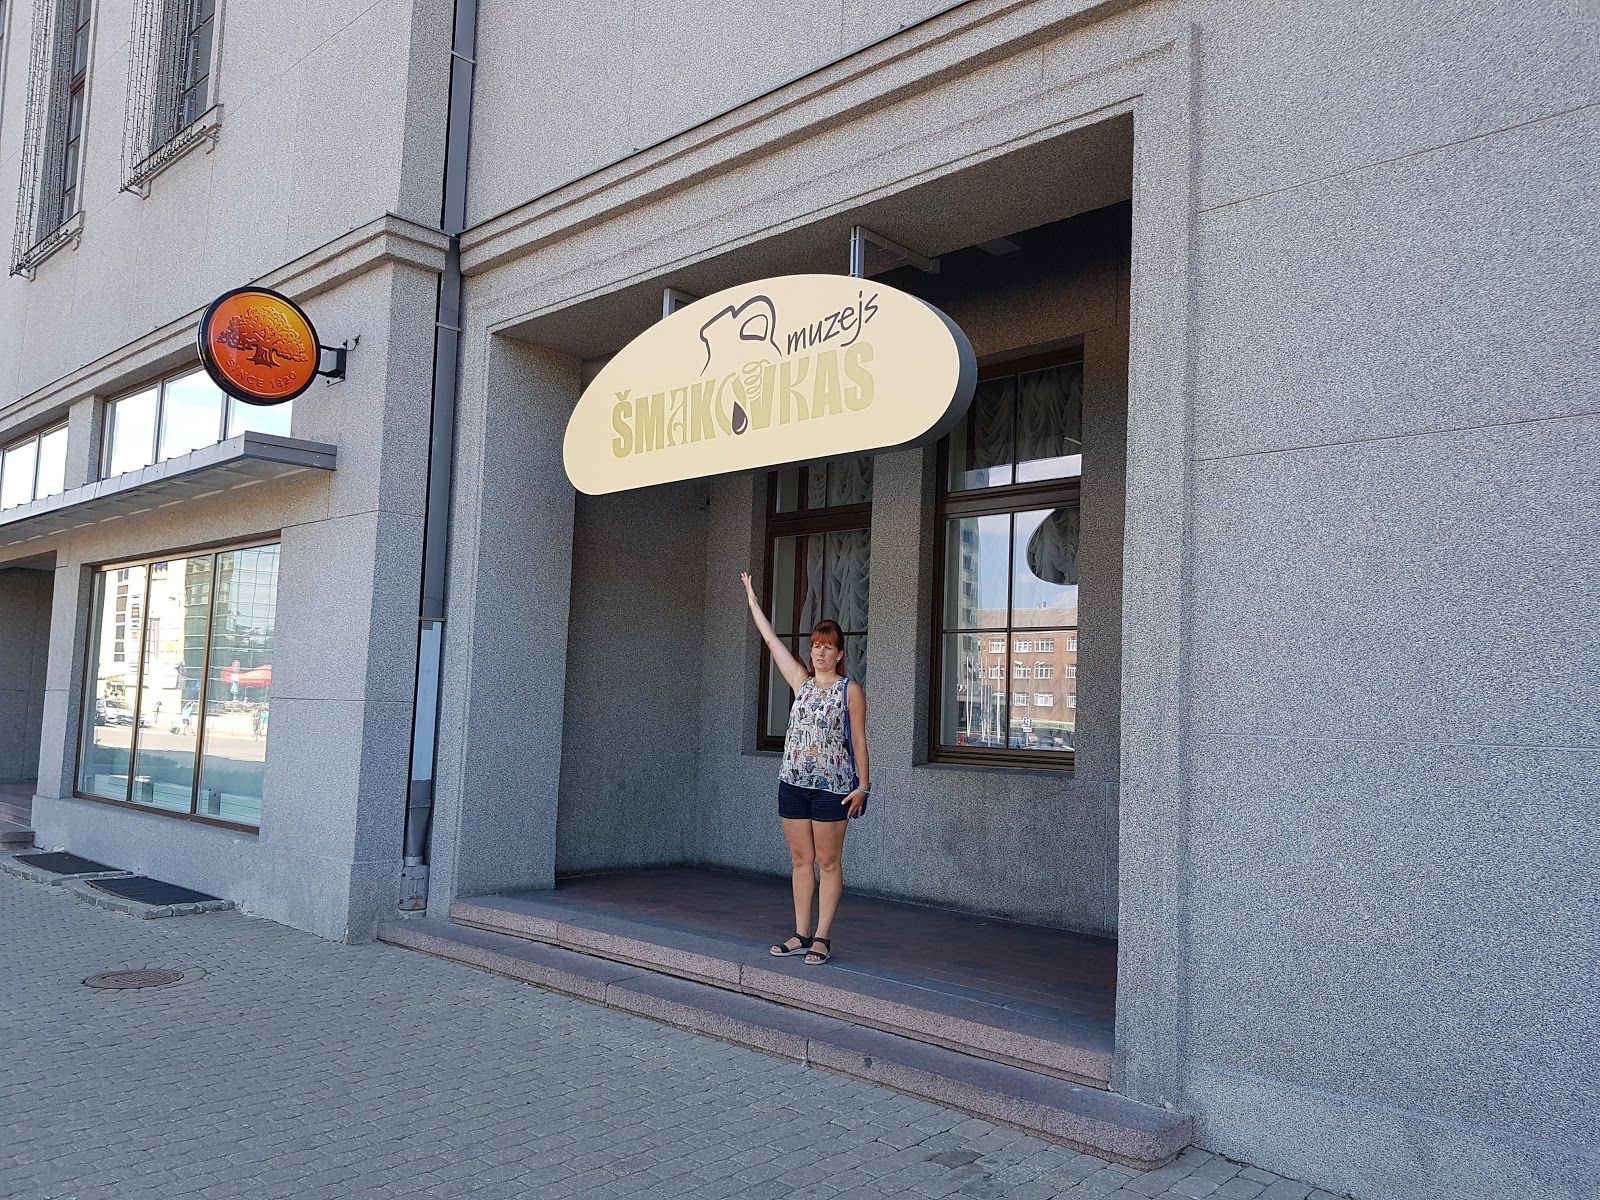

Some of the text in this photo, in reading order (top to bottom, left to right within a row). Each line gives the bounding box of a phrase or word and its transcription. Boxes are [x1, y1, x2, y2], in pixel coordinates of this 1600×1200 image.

[786, 290, 880, 356] muzejs
[226, 358, 297, 389] SINCE 1820
[611, 341, 875, 459] ŠMAKOVKAS
